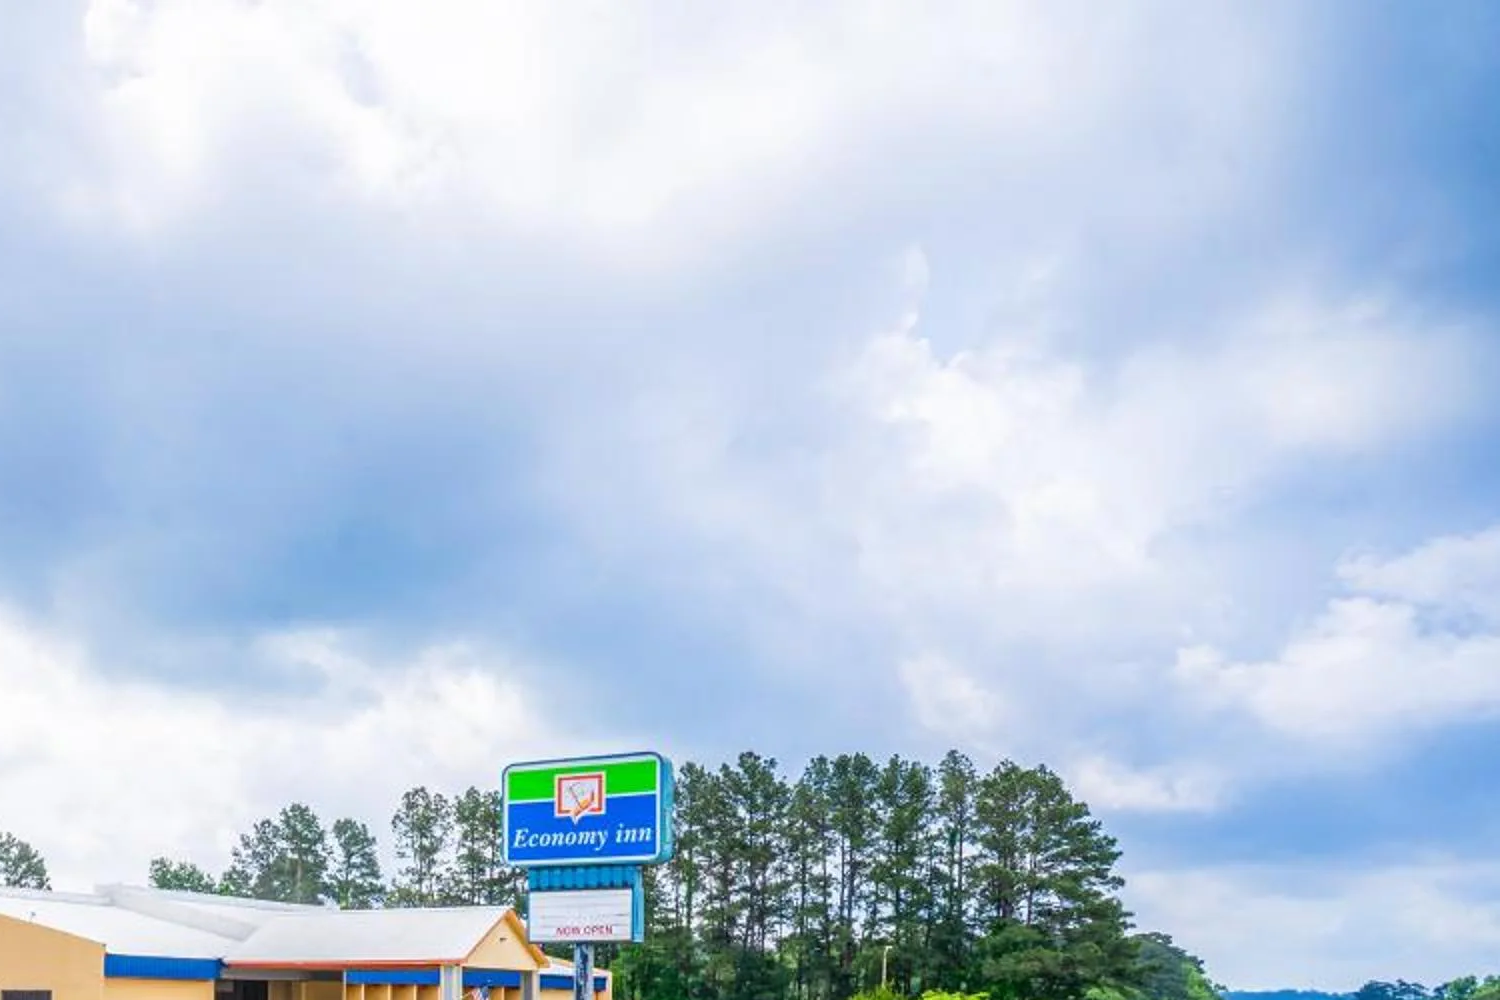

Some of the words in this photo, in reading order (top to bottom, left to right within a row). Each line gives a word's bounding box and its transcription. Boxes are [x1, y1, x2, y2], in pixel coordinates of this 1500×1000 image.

[513, 827, 608, 851] Economy
[615, 822, 652, 843] inn
[556, 926, 580, 936] NOW
[583, 924, 613, 936] OPEN
